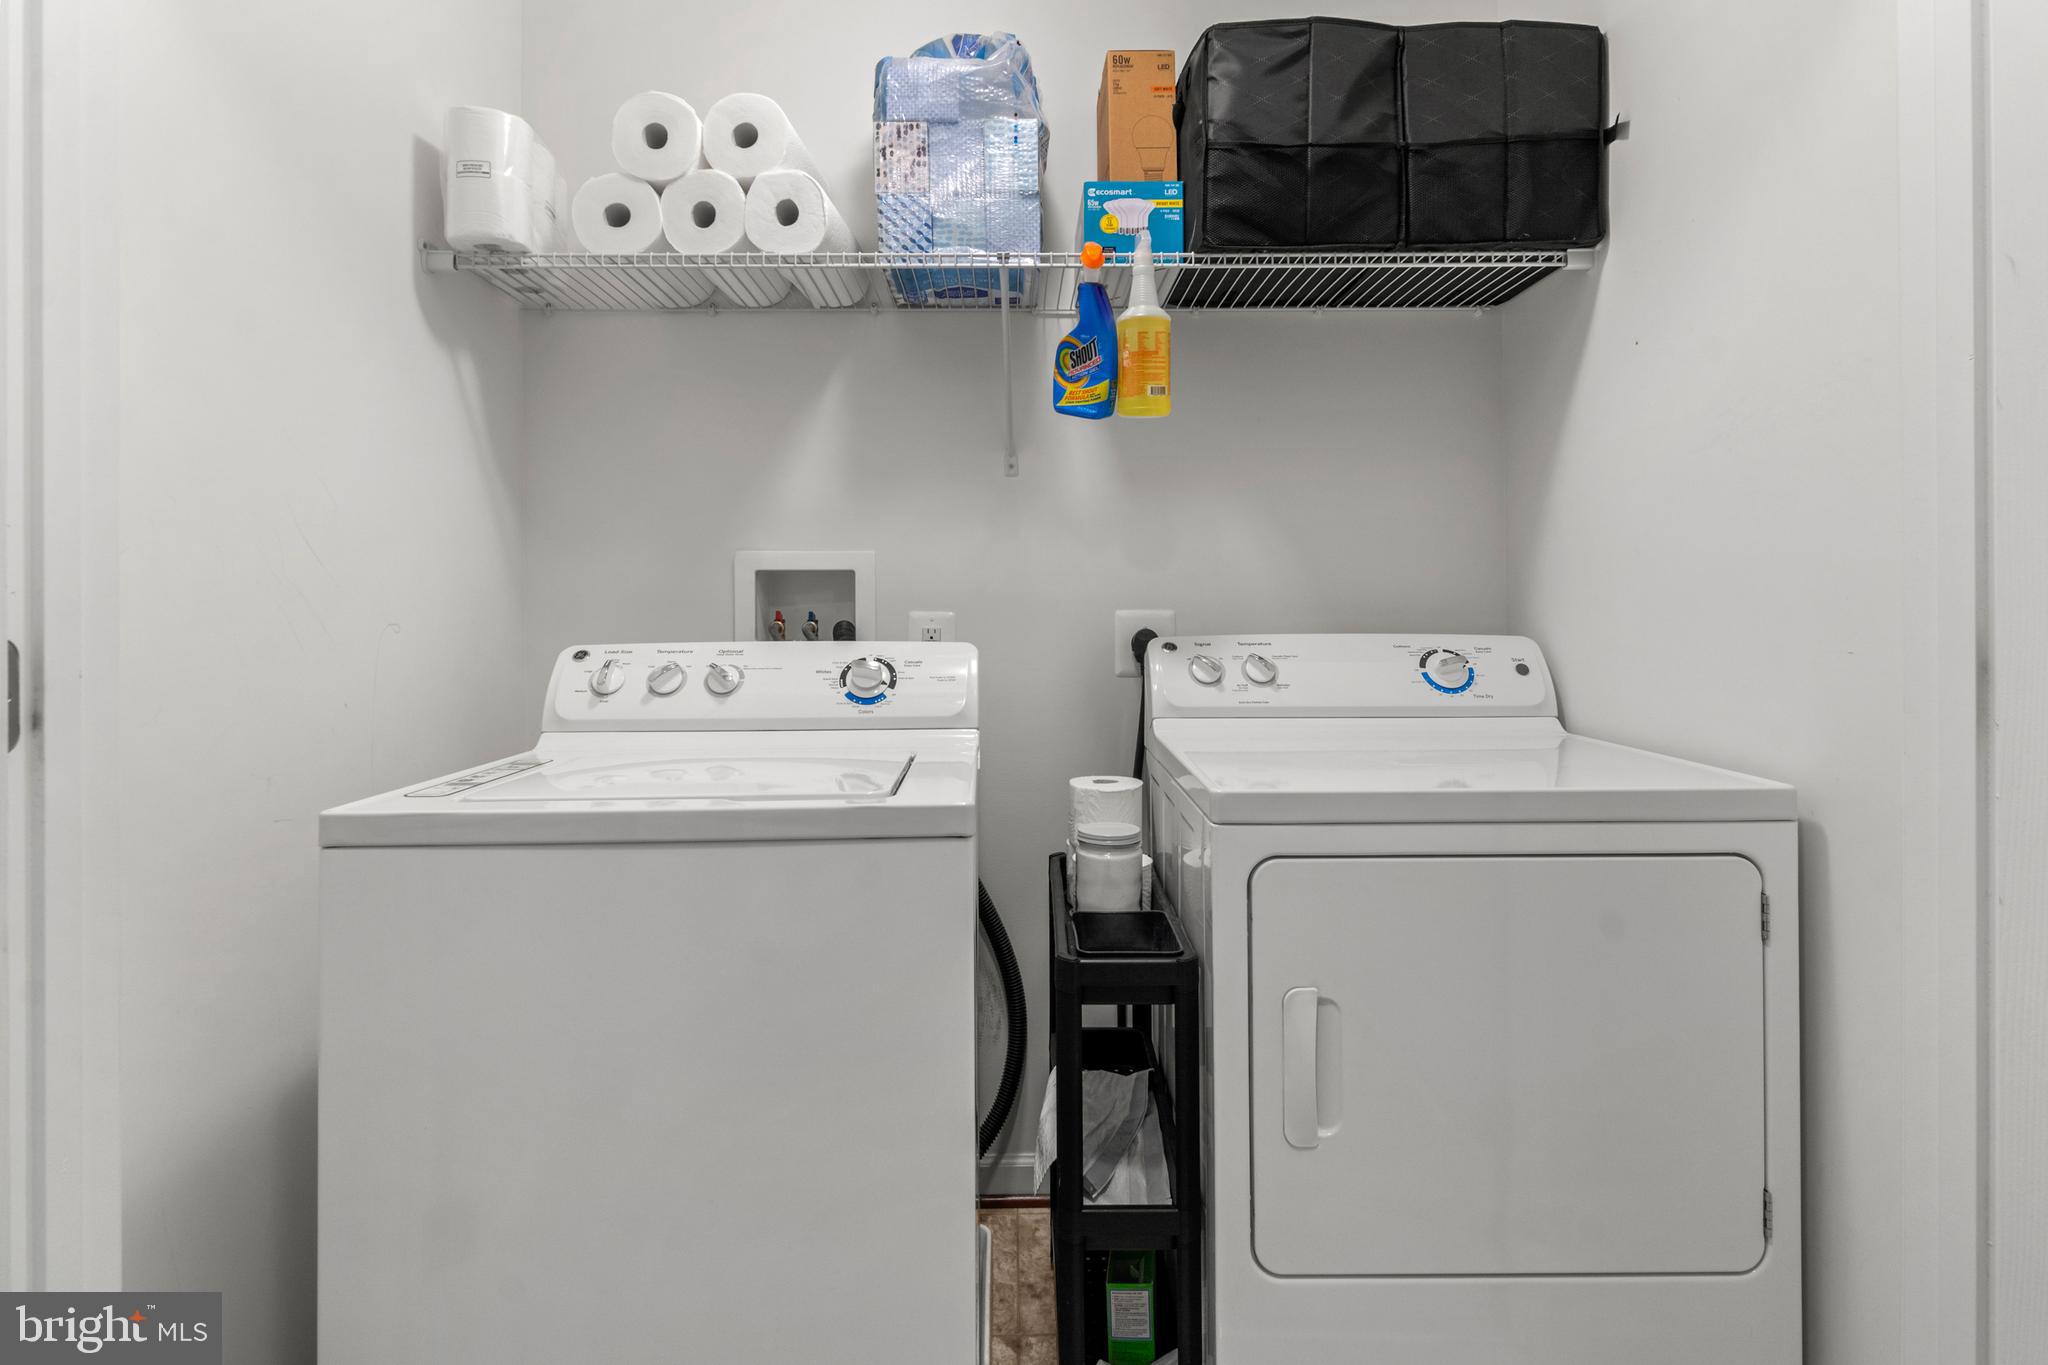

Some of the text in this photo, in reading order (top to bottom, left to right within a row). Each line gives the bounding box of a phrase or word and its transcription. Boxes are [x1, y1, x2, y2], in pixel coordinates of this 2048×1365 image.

[1095, 188, 1133, 196] ecosmart
[1164, 188, 1178, 196] LED
[1069, 336, 1099, 369] SHOUT
